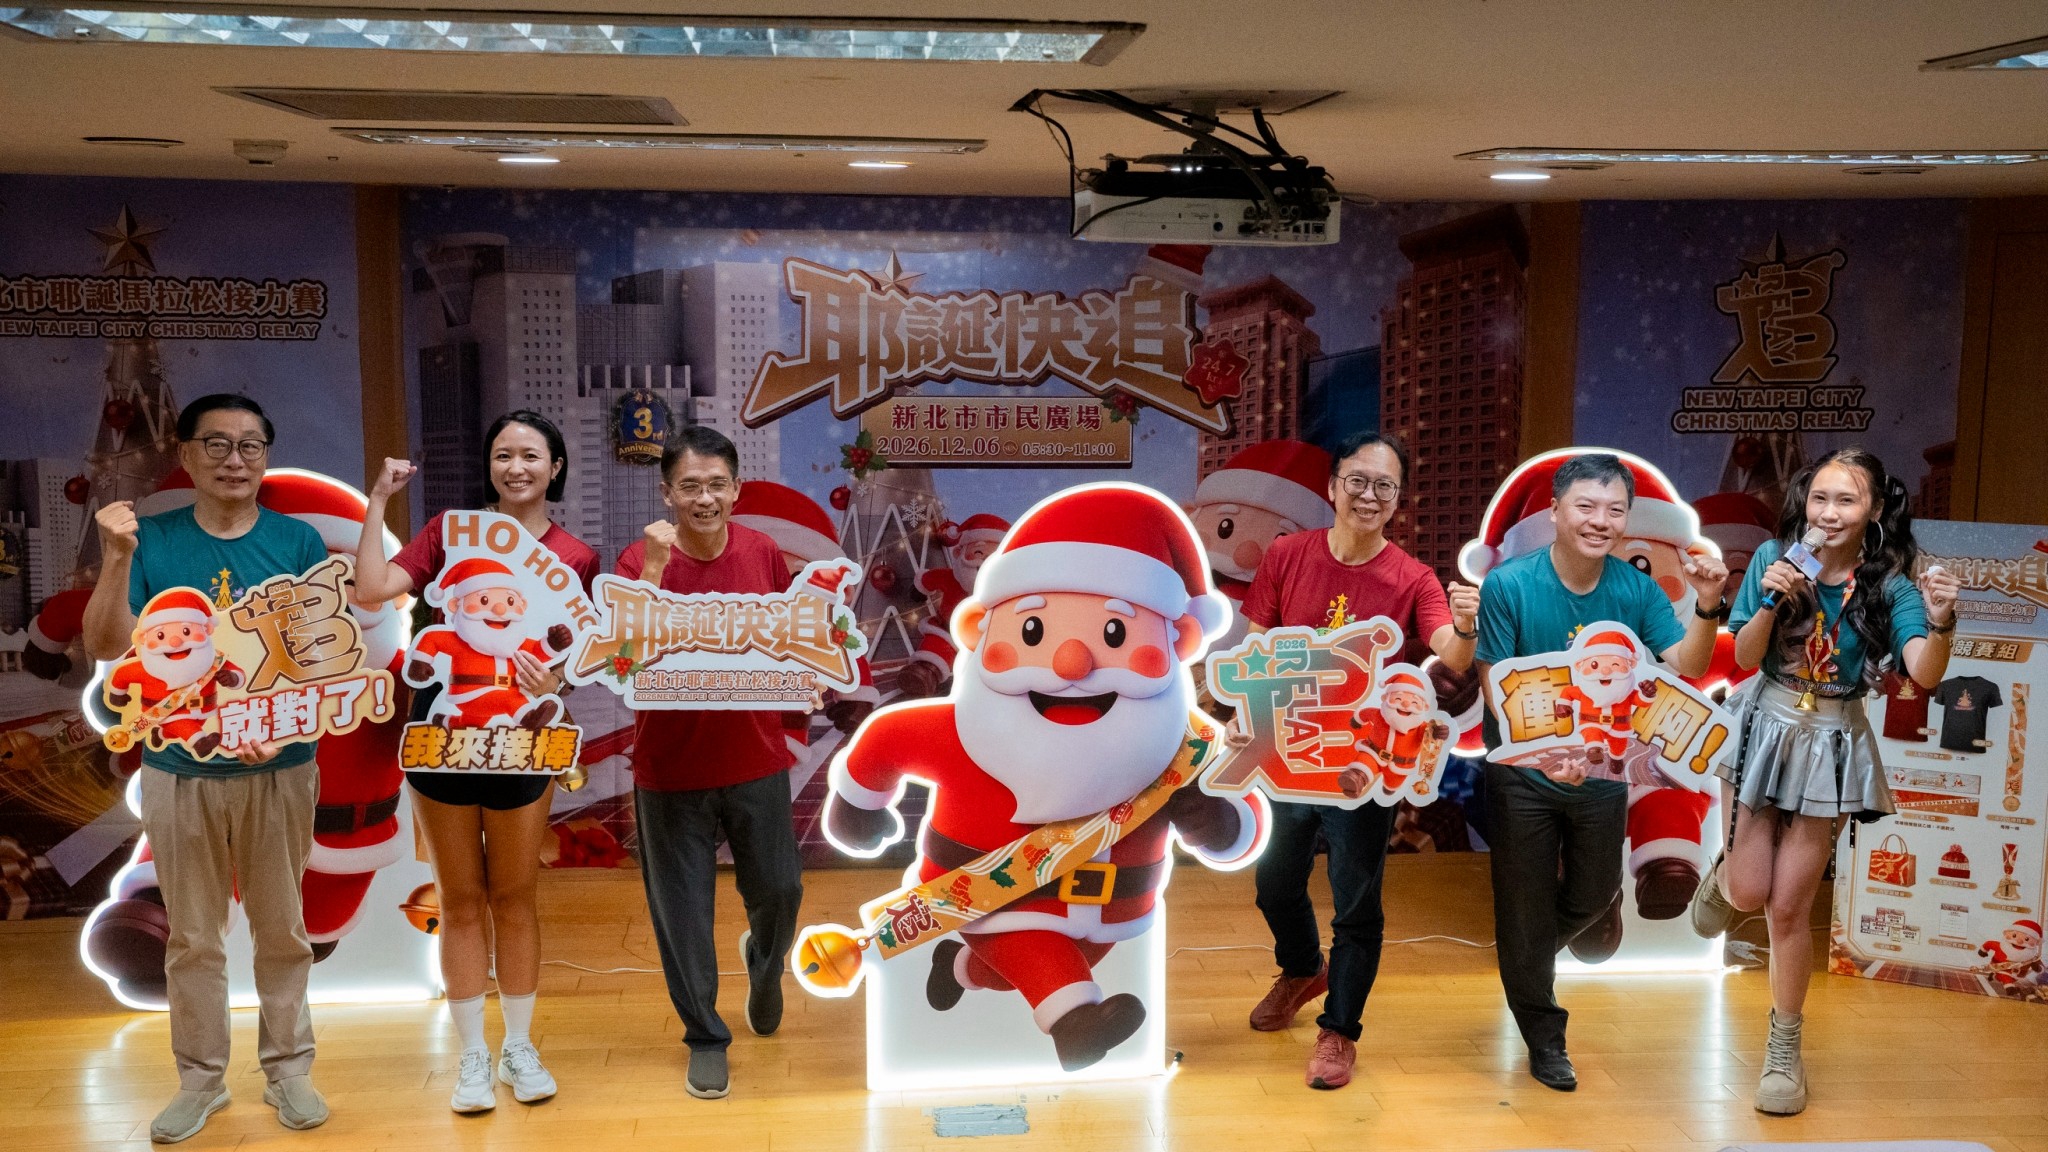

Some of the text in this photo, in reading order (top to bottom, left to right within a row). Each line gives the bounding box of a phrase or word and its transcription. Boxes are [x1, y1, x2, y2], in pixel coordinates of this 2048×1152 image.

[36, 320, 95, 335] TAIPEI
[100, 321, 147, 336] CITY
[149, 322, 256, 338] CHRISTMAS
[260, 323, 318, 339] RELAY
[742, 258, 1232, 434] 耶誕快追
[1684, 388, 1863, 408] NEW TAIPEI CITY
[891, 403, 1103, 431] 新北市市民廣場
[1674, 411, 1872, 431] CHRISTMAS RELAY
[876, 436, 1000, 456] 2026.12.06
[1021, 441, 1117, 457] 05:30~11:00
[448, 515, 520, 554] HO
[523, 548, 570, 592] HO
[574, 581, 855, 685] 耶誕快追
[1275, 639, 1307, 650] 2026
[634, 671, 817, 690] 新北市耶誕馬拉松接力賽
[635, 692, 812, 701] 2026NEW TAIPEI CITY CHRISTMAS RELAY
[1275, 650, 1323, 768] RELAY
[401, 725, 579, 771] 我來接棒
